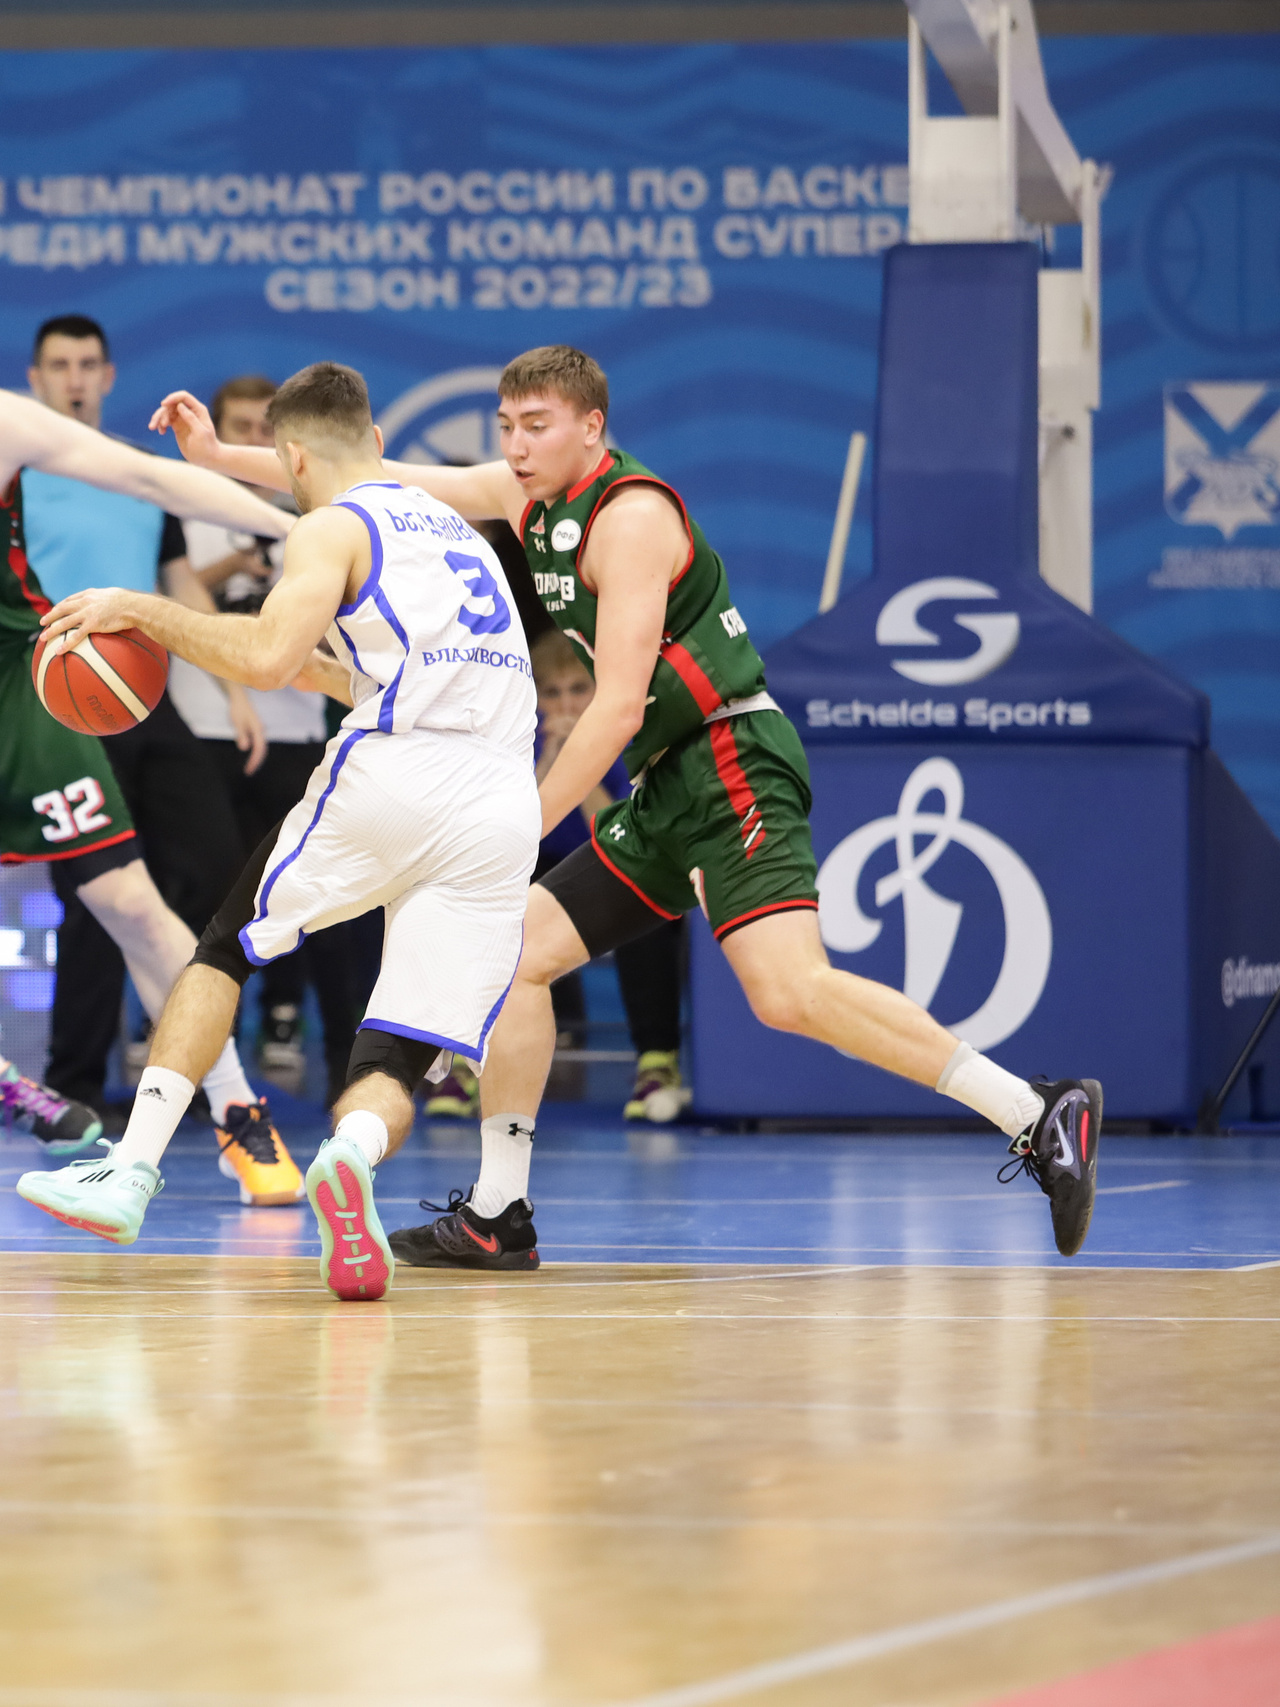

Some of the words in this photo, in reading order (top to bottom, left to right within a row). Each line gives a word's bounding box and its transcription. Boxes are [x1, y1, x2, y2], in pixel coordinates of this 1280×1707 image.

[18, 174, 364, 216] ЧЕМПИОНАТ
[379, 170, 613, 214] РОССИИ
[628, 167, 708, 210] ПО
[724, 165, 909, 209] БАСКЕ
[138, 219, 433, 264] МУЖСКИХ
[447, 216, 699, 263] КОМАНД
[714, 214, 903, 258] СУПЕР
[265, 268, 460, 312] СЕЗОН
[473, 264, 713, 310] 2022/23
[443, 550, 511, 635] 3
[806, 699, 957, 727] Schelde
[964, 698, 1092, 733] Sports
[32, 776, 112, 843] 32
